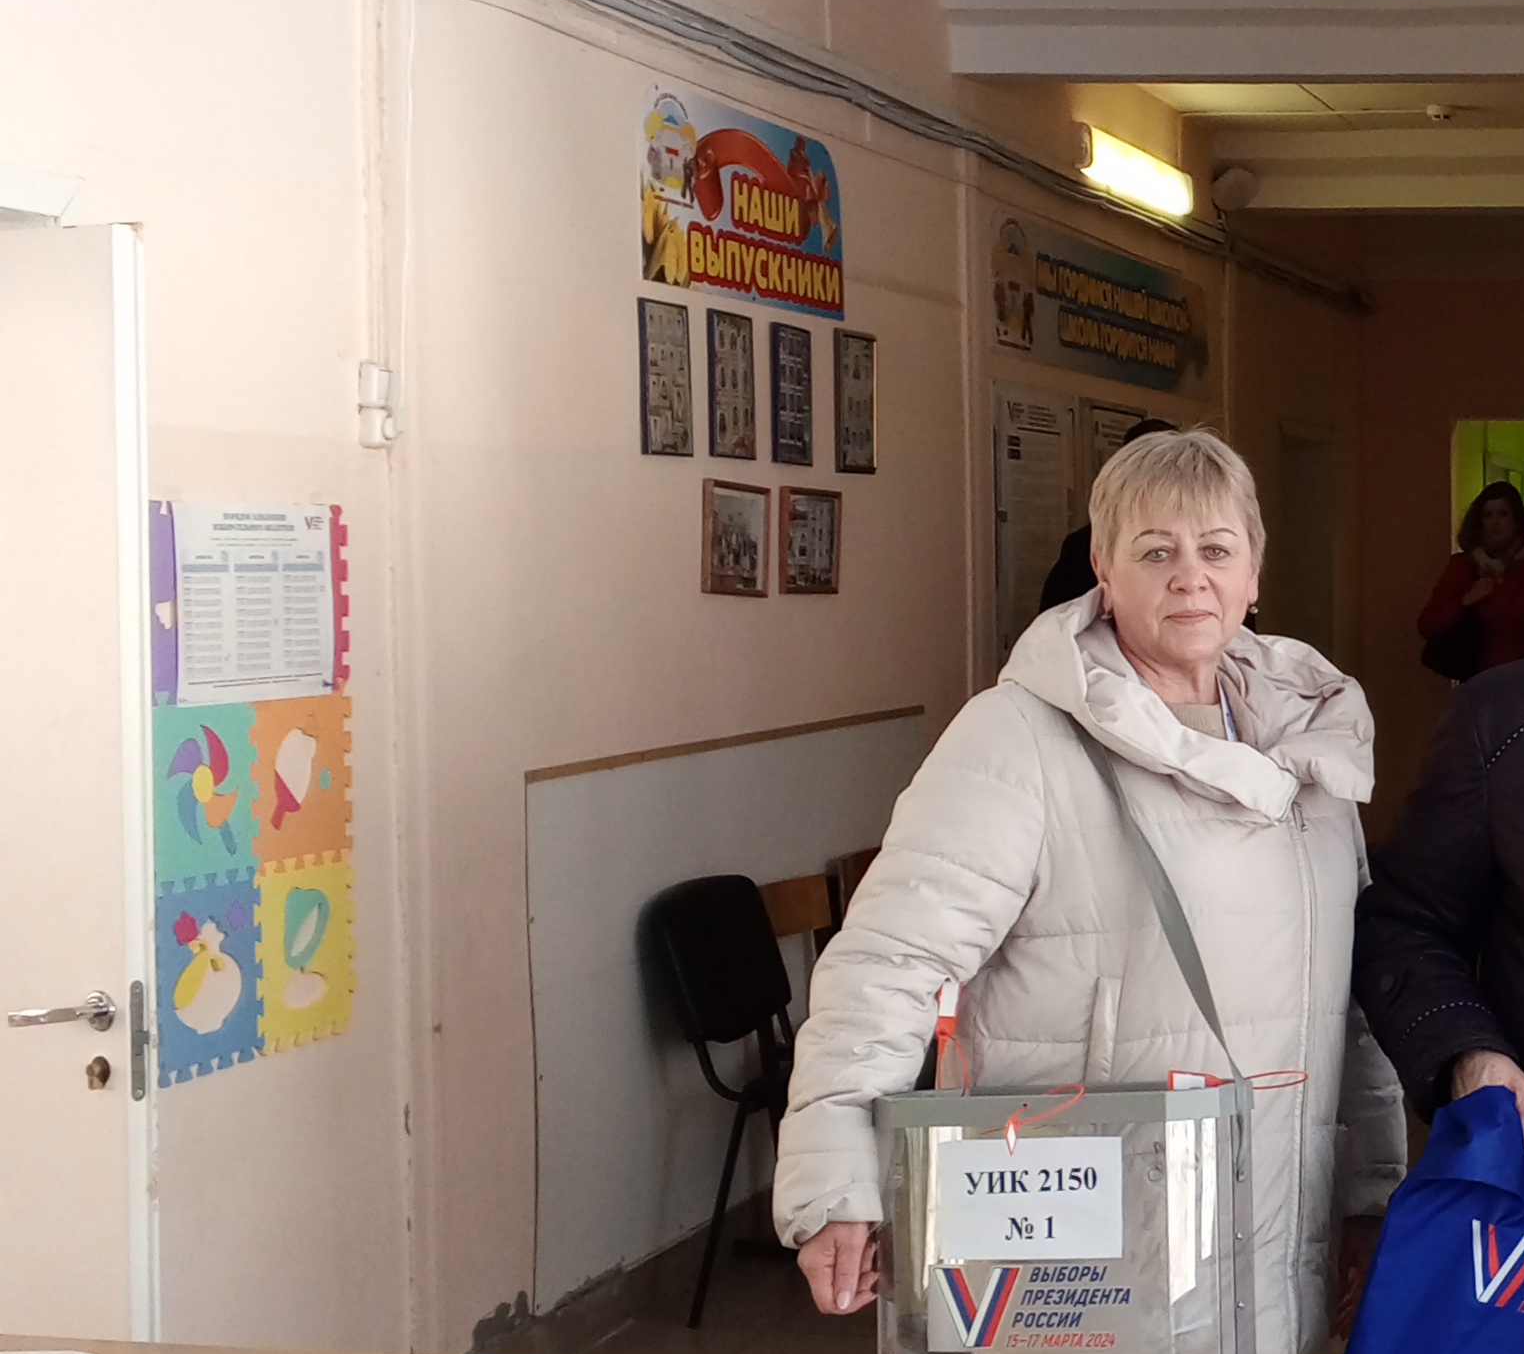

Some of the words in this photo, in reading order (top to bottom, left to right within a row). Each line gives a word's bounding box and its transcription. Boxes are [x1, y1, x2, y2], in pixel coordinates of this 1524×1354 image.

[733, 179, 800, 238] НАШИ
[690, 230, 841, 304] ВЫПУСКНИКИ
[964, 1169, 1029, 1196] УИК
[1038, 1166, 1098, 1194] 2150
[1004, 1217, 1035, 1241] №
[1044, 1215, 1055, 1239] 1
[1028, 1266, 1108, 1283] ВЫБОРЫ
[1020, 1288, 1131, 1307] ПРЕЗИДЕНТА
[1011, 1311, 1083, 1329] РОССИИ
[1040, 1332, 1083, 1348] МАРТА
[1085, 1332, 1116, 1348] 2024
